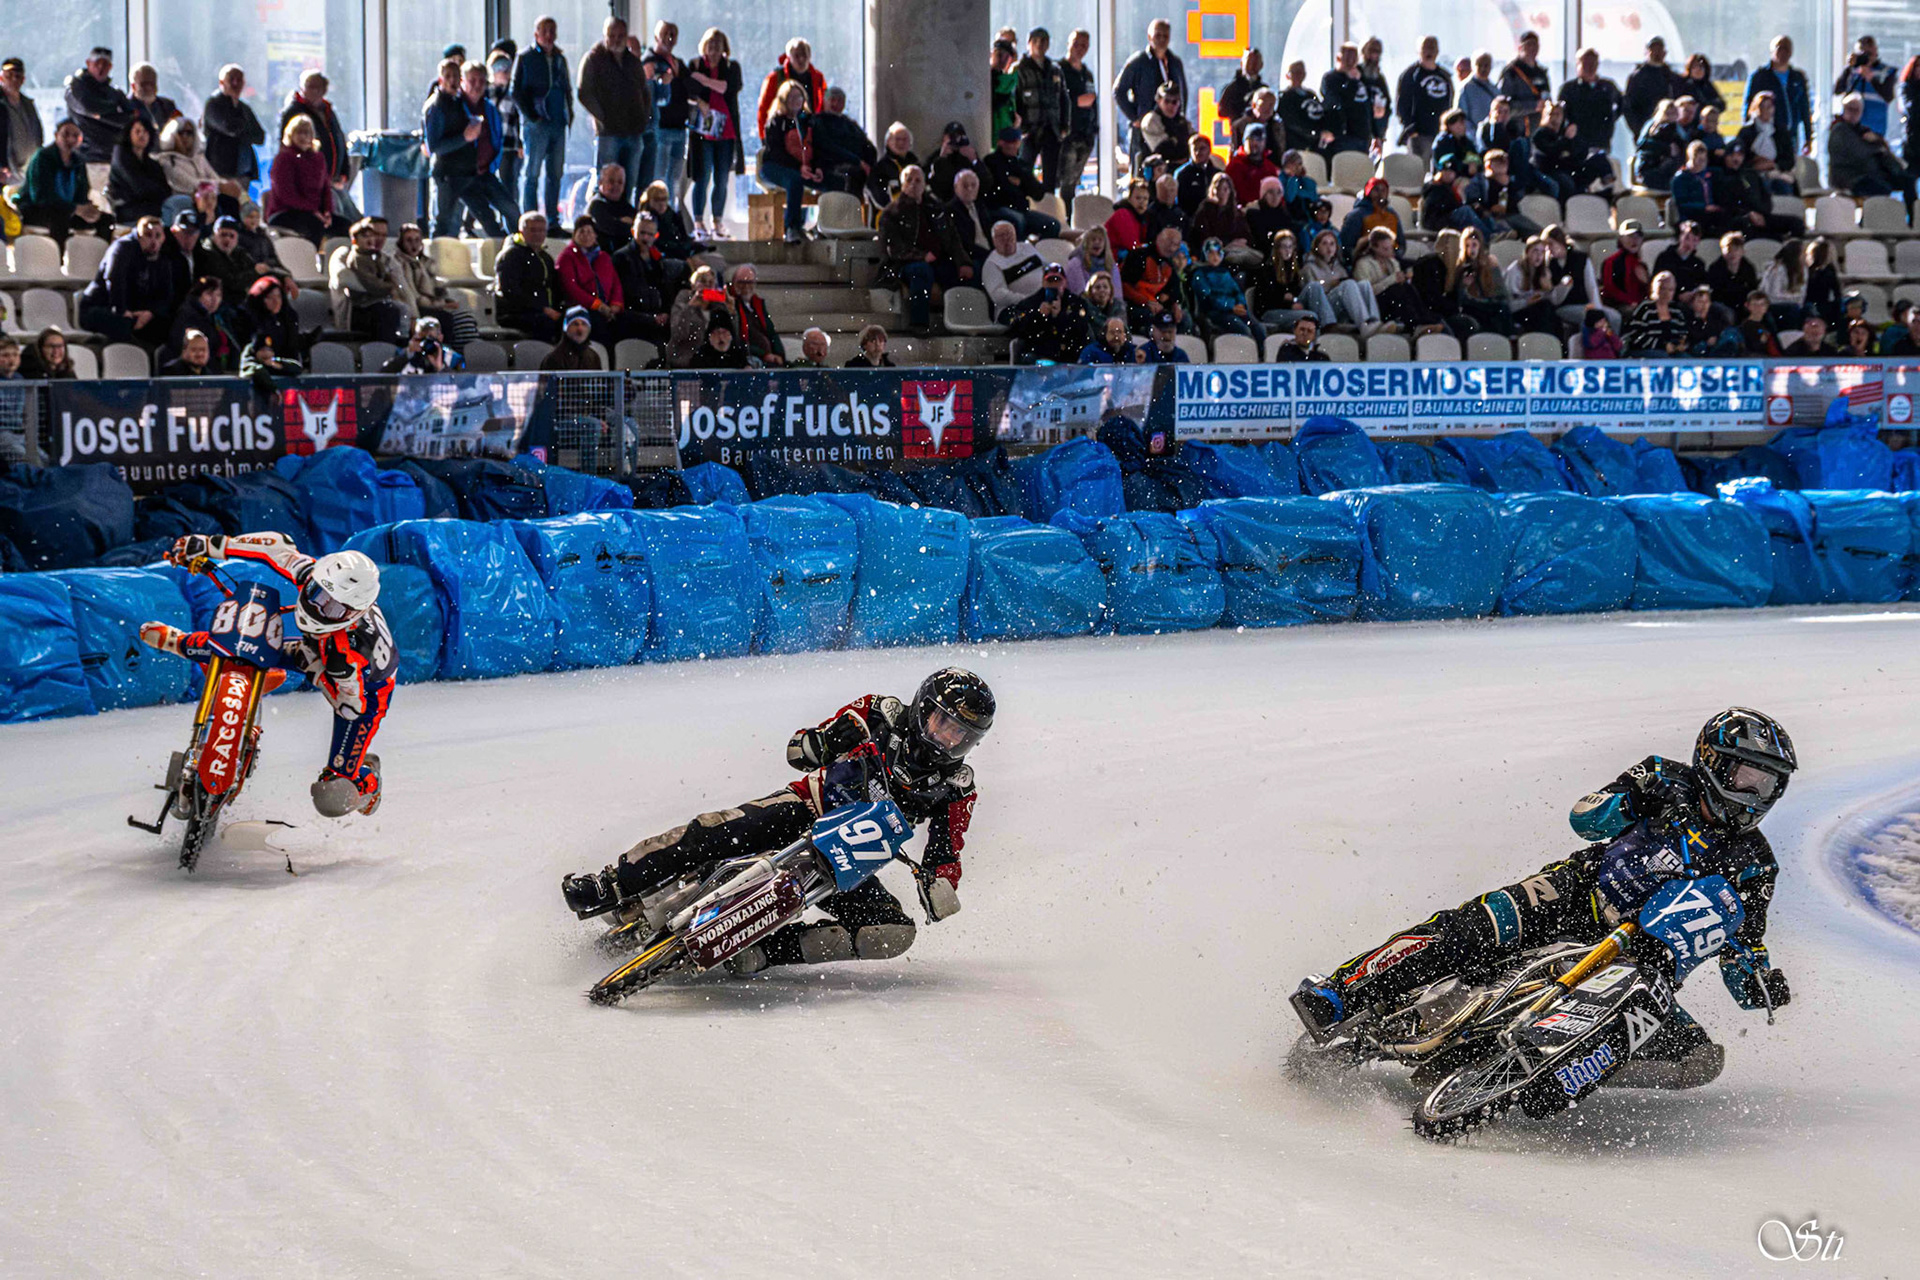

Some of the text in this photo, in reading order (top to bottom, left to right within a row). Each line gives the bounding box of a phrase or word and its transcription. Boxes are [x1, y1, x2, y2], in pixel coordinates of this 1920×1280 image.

[1178, 369, 1292, 399] MOSER
[1295, 368, 1409, 397] MOSER
[1412, 367, 1525, 396] MOSER
[1530, 366, 1644, 394] MOSER
[1650, 365, 1764, 393] MOSER
[678, 391, 891, 450] Josef Fuchs
[1179, 402, 1290, 419] BAUMASCHINEN
[1297, 401, 1408, 417] BAUMASCHINEN
[1413, 400, 1525, 415] BAUMASCHINEN
[1531, 399, 1645, 413] BAUMASCHINEN
[59, 402, 275, 467] Josef Fuchs
[314, 416, 328, 436] JF
[838, 819, 893, 861] 97
[697, 889, 778, 948] NORDMALINGS
[1659, 888, 1726, 958] 719
